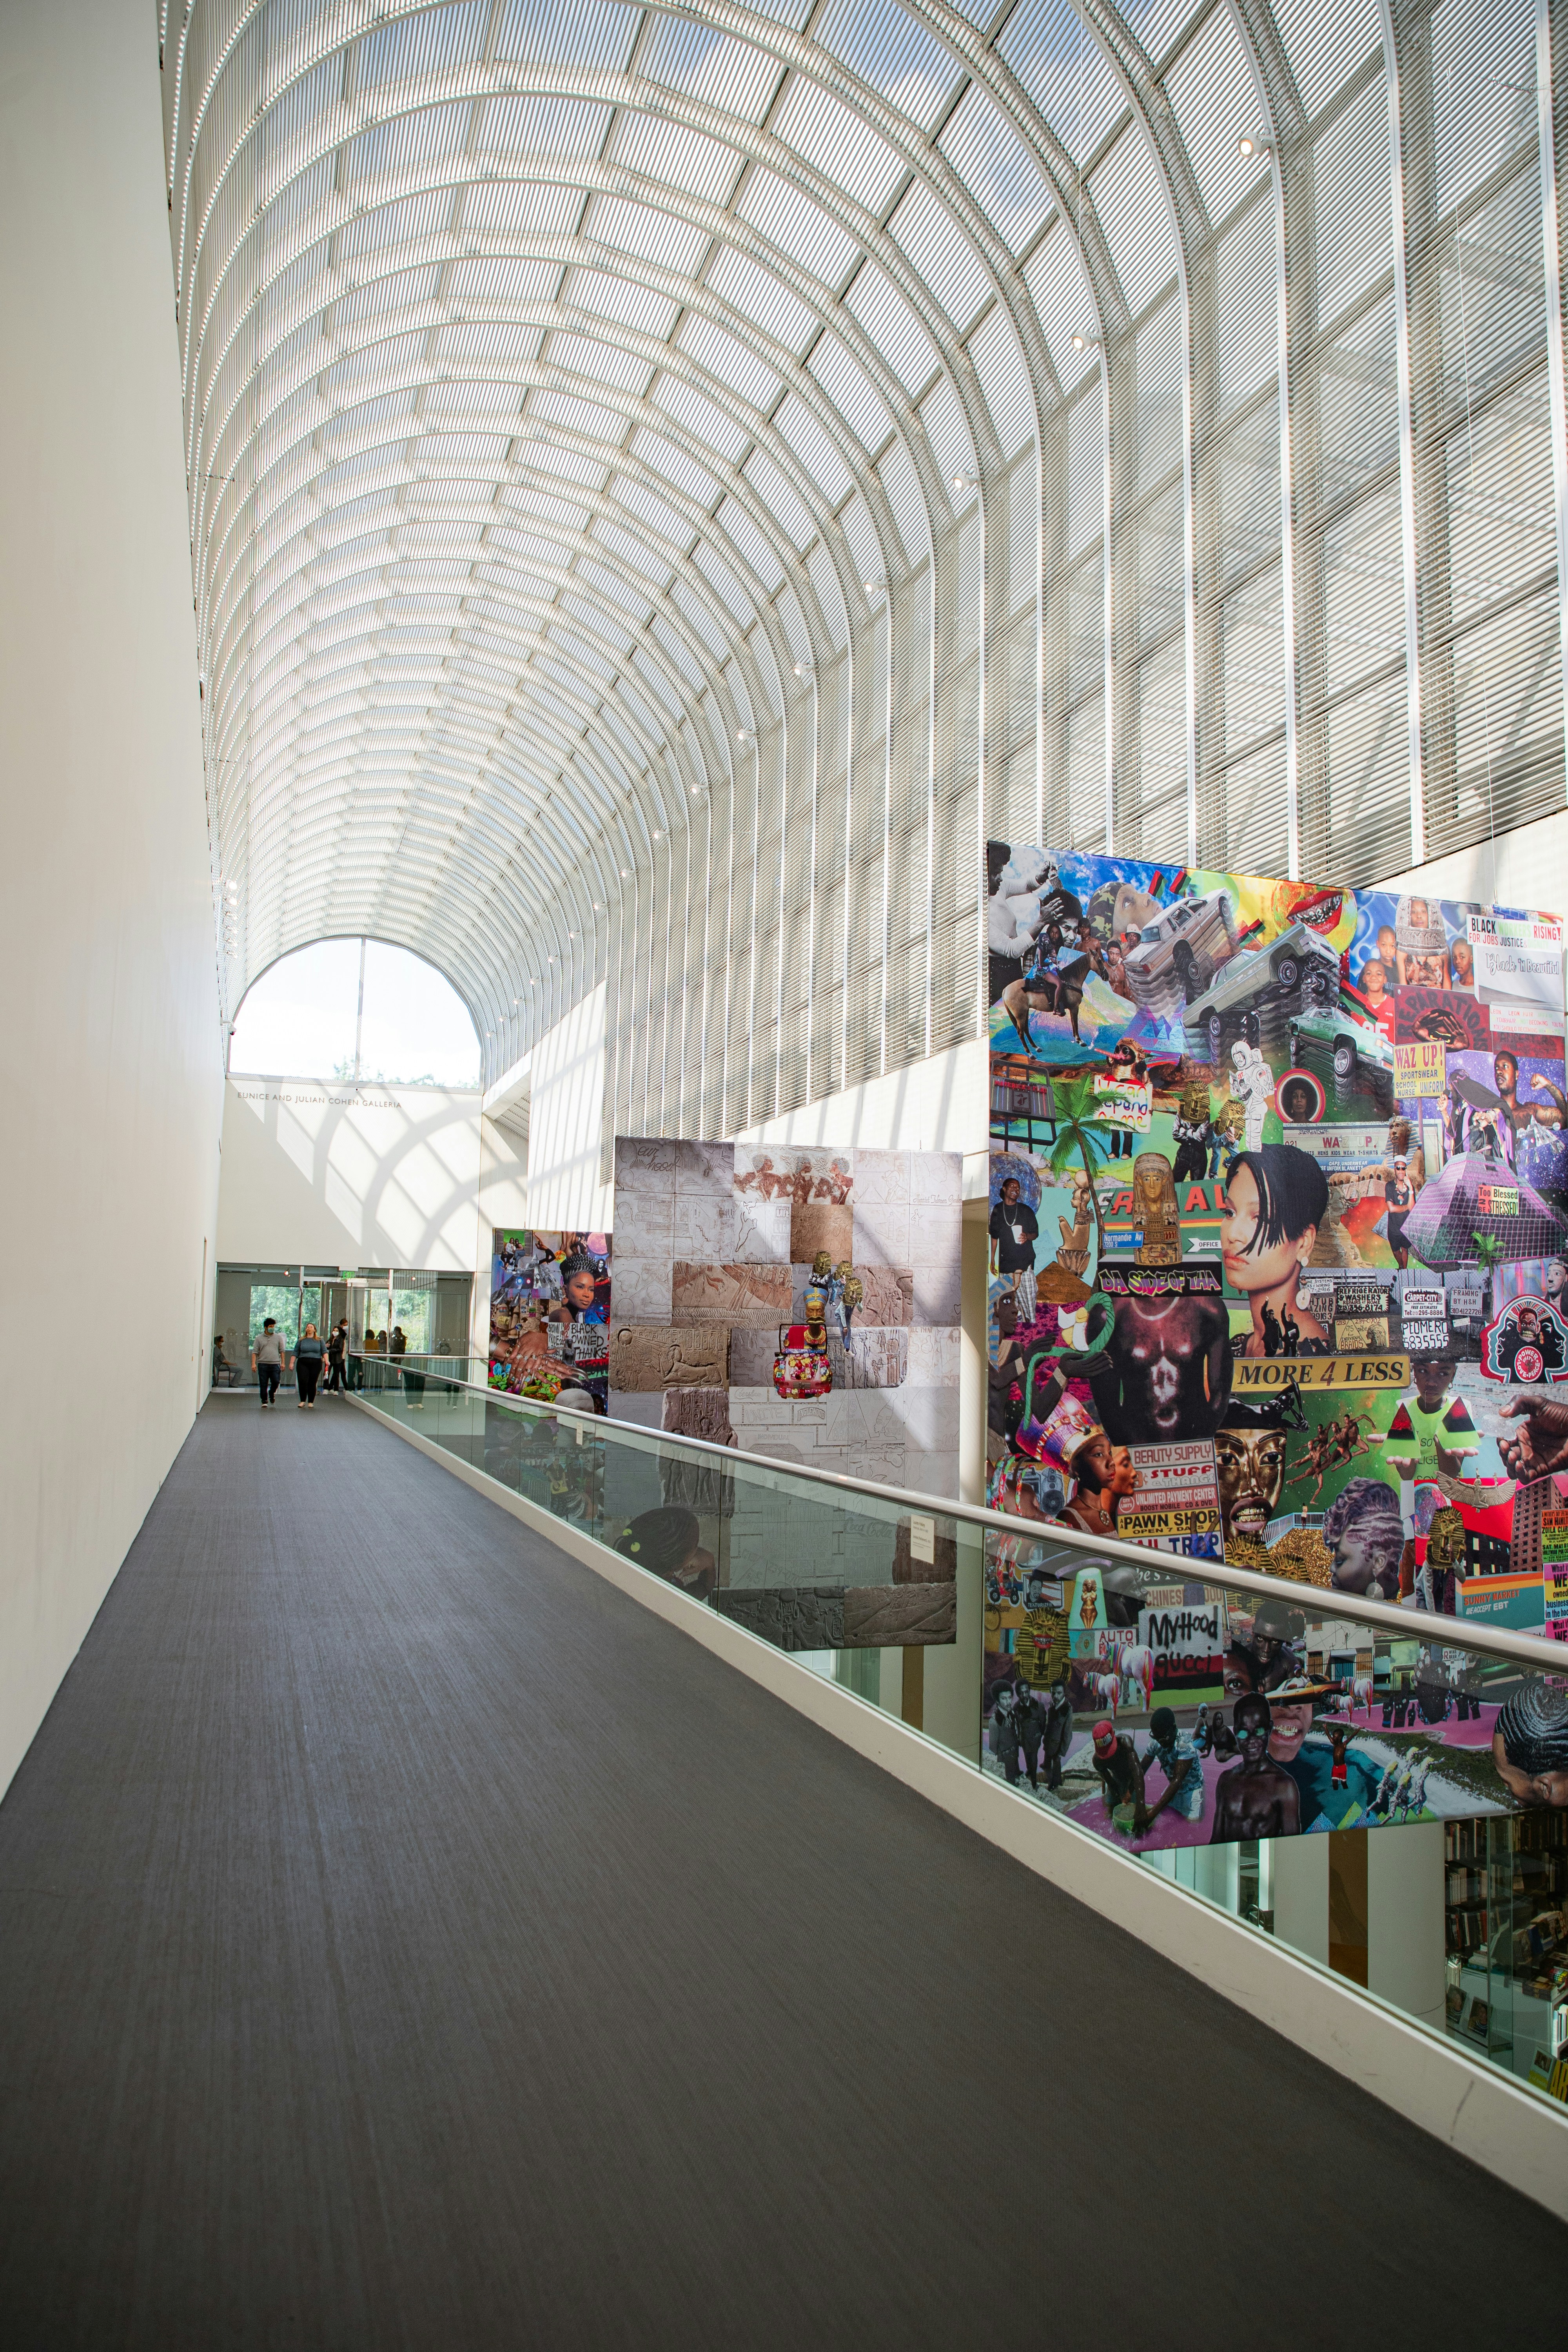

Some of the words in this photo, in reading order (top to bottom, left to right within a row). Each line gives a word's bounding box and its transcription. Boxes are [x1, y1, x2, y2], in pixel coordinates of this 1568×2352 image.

[1472, 918, 1496, 934] BLACK
[1498, 922, 1531, 937] WORKERS
[1534, 925, 1561, 940] RISING!
[1469, 933, 1480, 943] FOR
[1483, 935, 1498, 945] JOBS
[1500, 937, 1523, 947] JUSTICE
[1486, 953, 1516, 975] Black
[1527, 959, 1559, 975] Beautiful
[1397, 990, 1488, 1051] REPARATIONS
[1395, 1047, 1416, 1070] WAZ
[1423, 1044, 1443, 1067] UP!
[1401, 1069, 1438, 1080] SPORTSWEAR
[1420, 1080, 1444, 1094] UNIFORM
[363, 1100, 401, 1108] GALLERIA
[913, 1194, 929, 1203] Harriet
[931, 1194, 947, 1203] Tubman
[1494, 1189, 1518, 1199] Blessed
[1488, 1200, 1518, 1215] STRESSED!
[1104, 1234, 1131, 1242] Normandie
[1135, 1233, 1141, 1241] Av
[1098, 1269, 1130, 1295] DA
[1168, 1270, 1185, 1293] OF
[1185, 1270, 1222, 1290] THA
[549, 1323, 560, 1334] BROWN
[572, 1323, 597, 1334] BLACK
[549, 1333, 559, 1345] PRIDE
[572, 1335, 604, 1348] OWNED
[1341, 1339, 1363, 1349] BRAIDS
[1403, 1334, 1448, 1349] 5835555
[573, 1347, 608, 1360] THANKS
[1518, 1349, 1538, 1361] POWER
[1237, 1365, 1312, 1384] MORE
[1320, 1361, 1336, 1386] 4
[1343, 1362, 1403, 1382] LESS
[1517, 1362, 1526, 1377] LOVE
[1528, 1362, 1540, 1378] PEACE
[734, 1388, 761, 1400] Crenshaw
[745, 1407, 786, 1423] UNITE
[797, 1407, 825, 1422] INGLEWOOD
[833, 1428, 866, 1440] BRAIDS
[1134, 1448, 1172, 1464] BEAUTY
[1175, 1444, 1210, 1461] SUPPLY
[1151, 1465, 1214, 1479] STUFF
[1163, 1473, 1214, 1486] THANGS
[1136, 1493, 1165, 1504] UNLIMITED
[1167, 1490, 1192, 1502] PAYMENT
[1194, 1487, 1215, 1500] CENTER
[1124, 1514, 1169, 1530] PAWN
[1174, 1510, 1217, 1526] SHOP
[1551, 1564, 1564, 1573] What
[1553, 1573, 1567, 1588] WE
[1205, 1587, 1222, 1602] OOD
[1464, 1594, 1491, 1606] SUNNY
[1493, 1590, 1519, 1601] MARKET
[1553, 1588, 1568, 1598] owned
[1473, 1604, 1491, 1613] ACCEPT
[1493, 1601, 1508, 1611] EBT
[1546, 1610, 1550, 1618] in
[1553, 1621, 1564, 1630] What
[1099, 1630, 1133, 1642] AUTO
